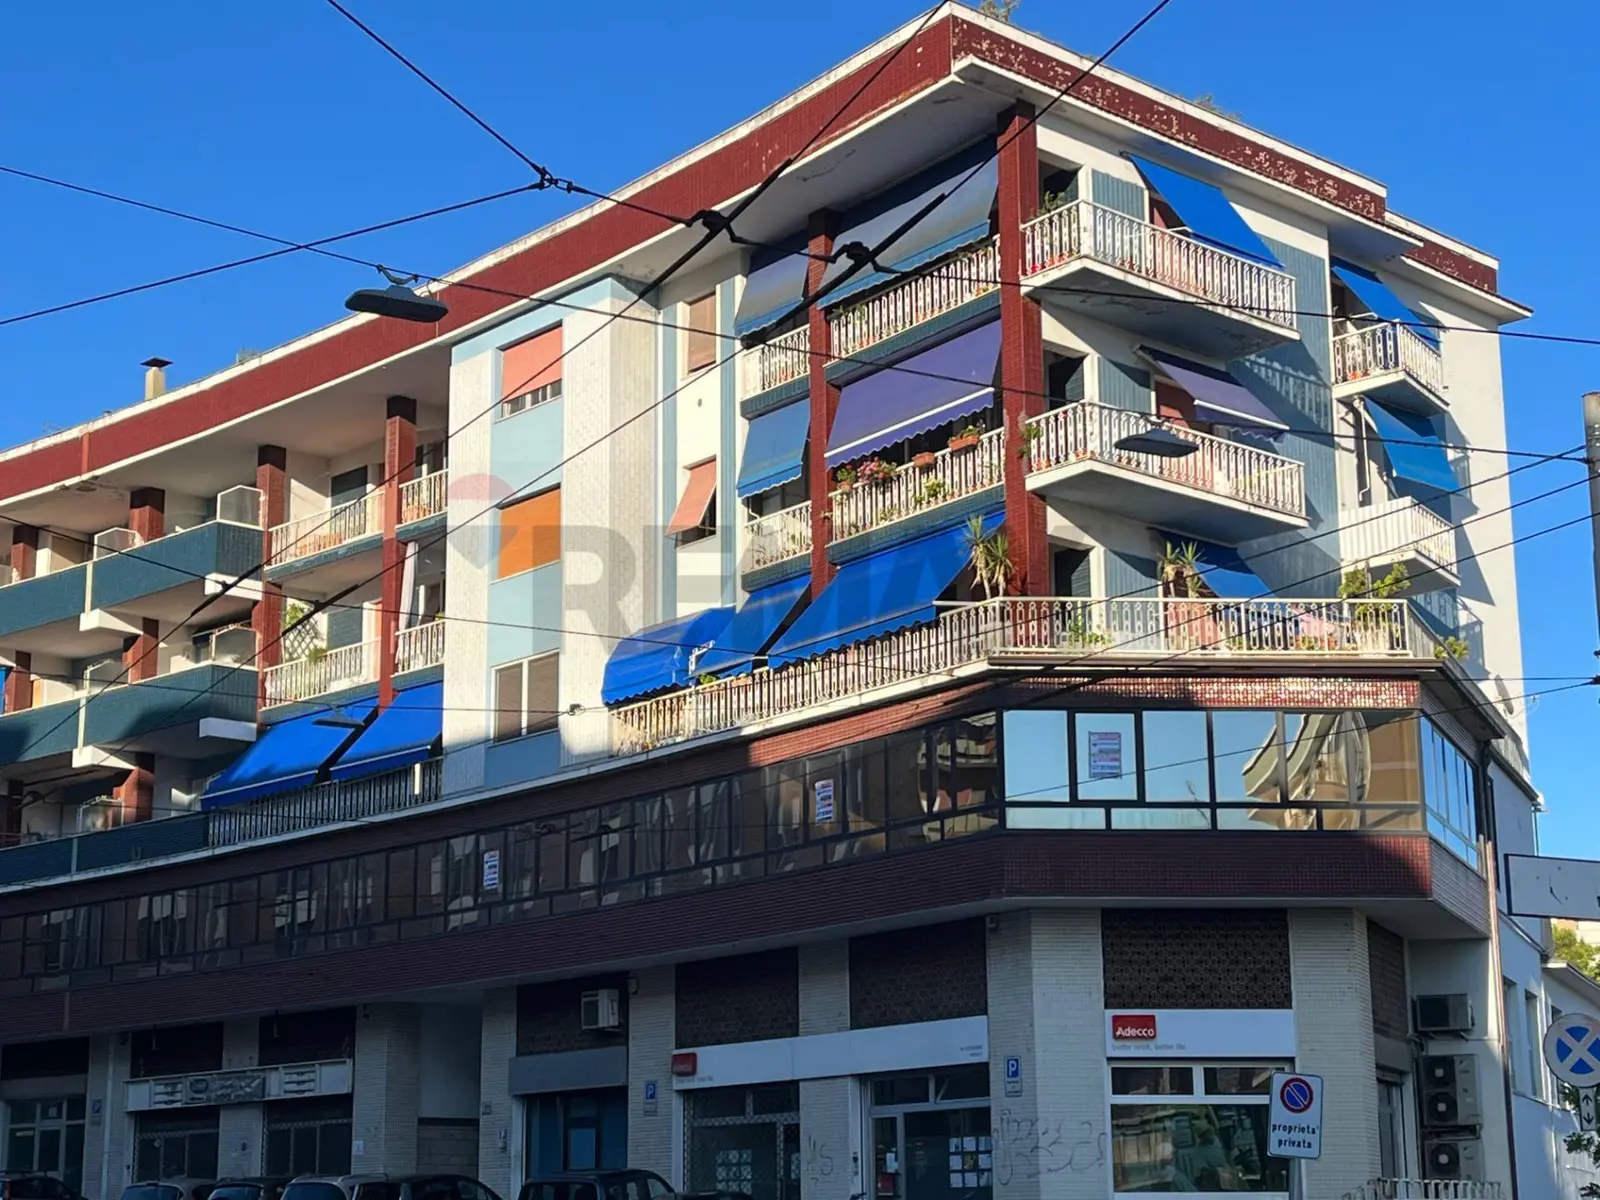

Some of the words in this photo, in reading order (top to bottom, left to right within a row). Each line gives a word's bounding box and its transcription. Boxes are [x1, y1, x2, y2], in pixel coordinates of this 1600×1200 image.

[1115, 1026, 1155, 1037] Adecco
[1008, 1060, 1017, 1076] P
[646, 1085, 655, 1099] P
[1277, 1137, 1313, 1149] privata
